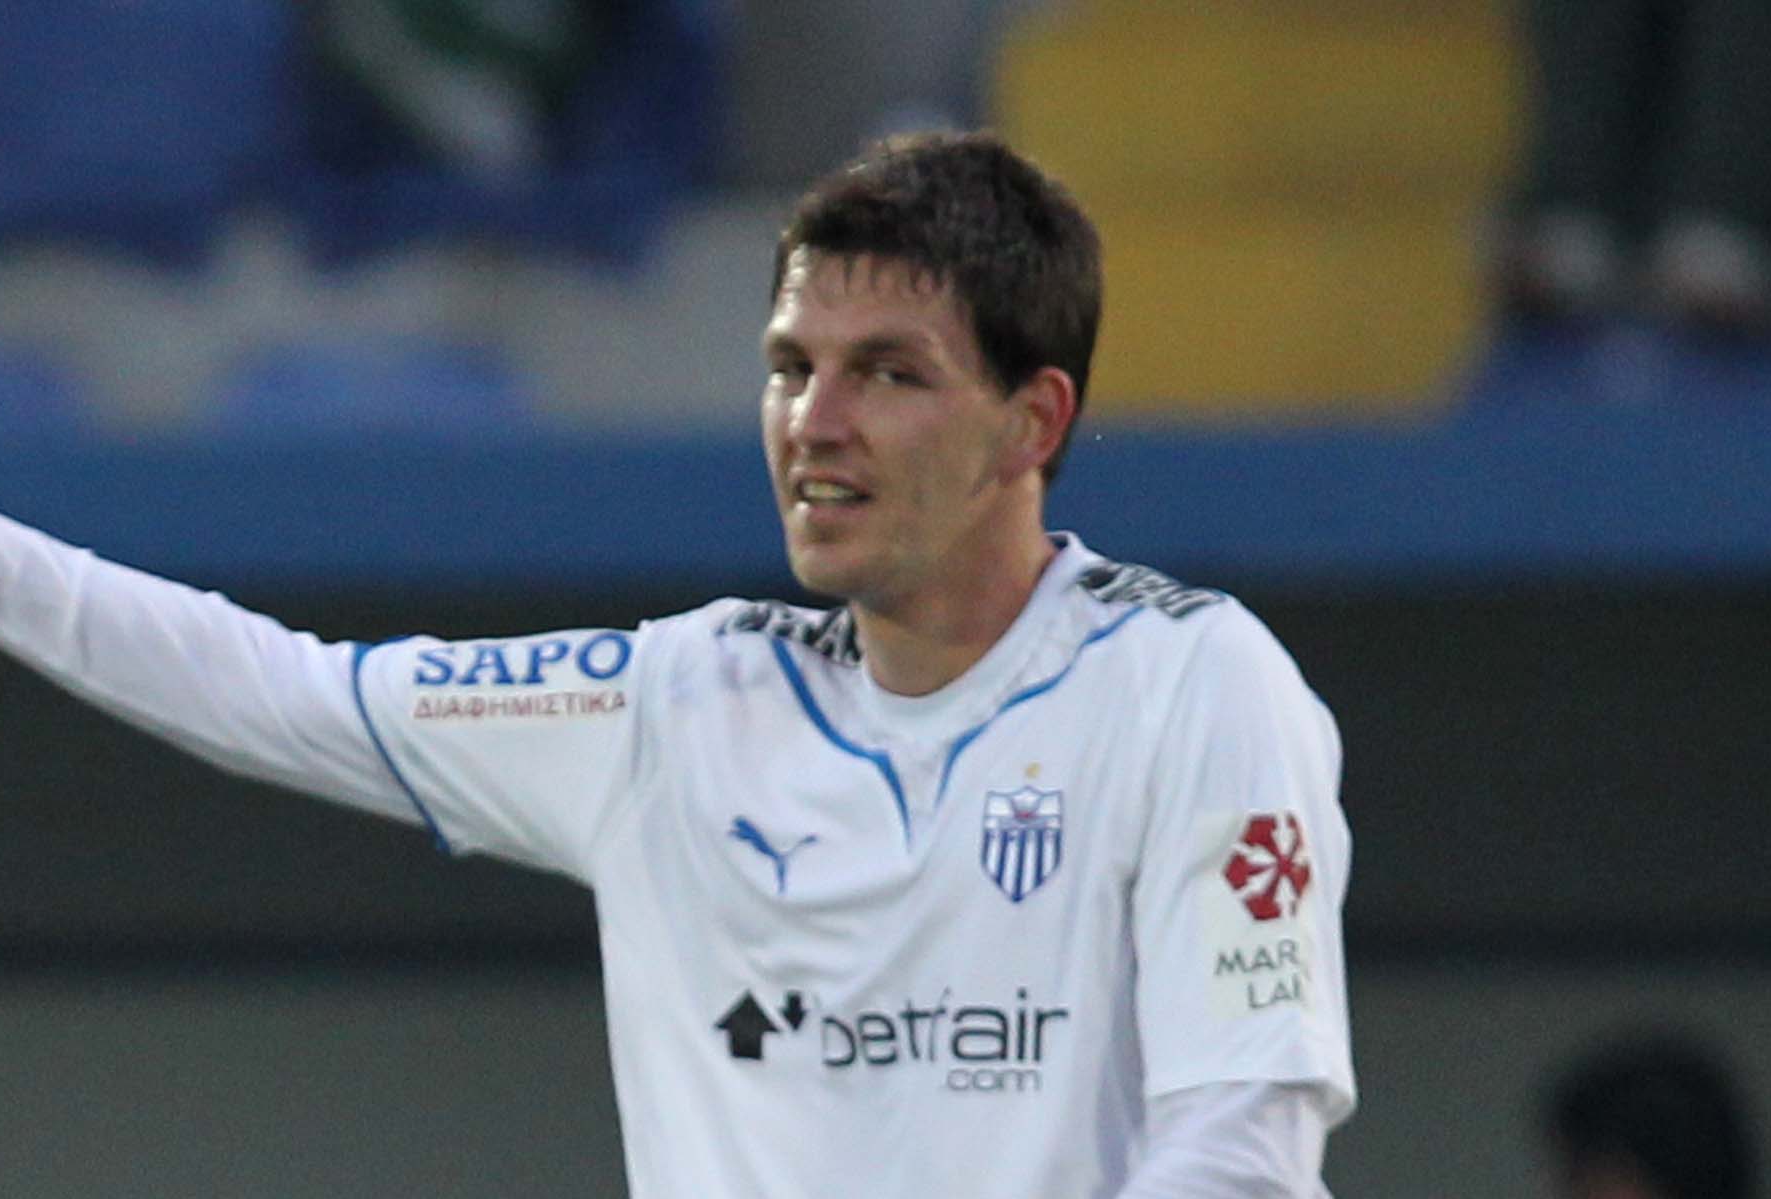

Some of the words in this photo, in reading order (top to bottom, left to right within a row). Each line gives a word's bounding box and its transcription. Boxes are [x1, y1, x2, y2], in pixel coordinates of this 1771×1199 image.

[414, 631, 632, 686] SAPO
[1215, 938, 1302, 976] MAR
[1247, 974, 1304, 1009] LAI
[821, 986, 1070, 1067] betfair
[947, 1067, 1043, 1092] com
